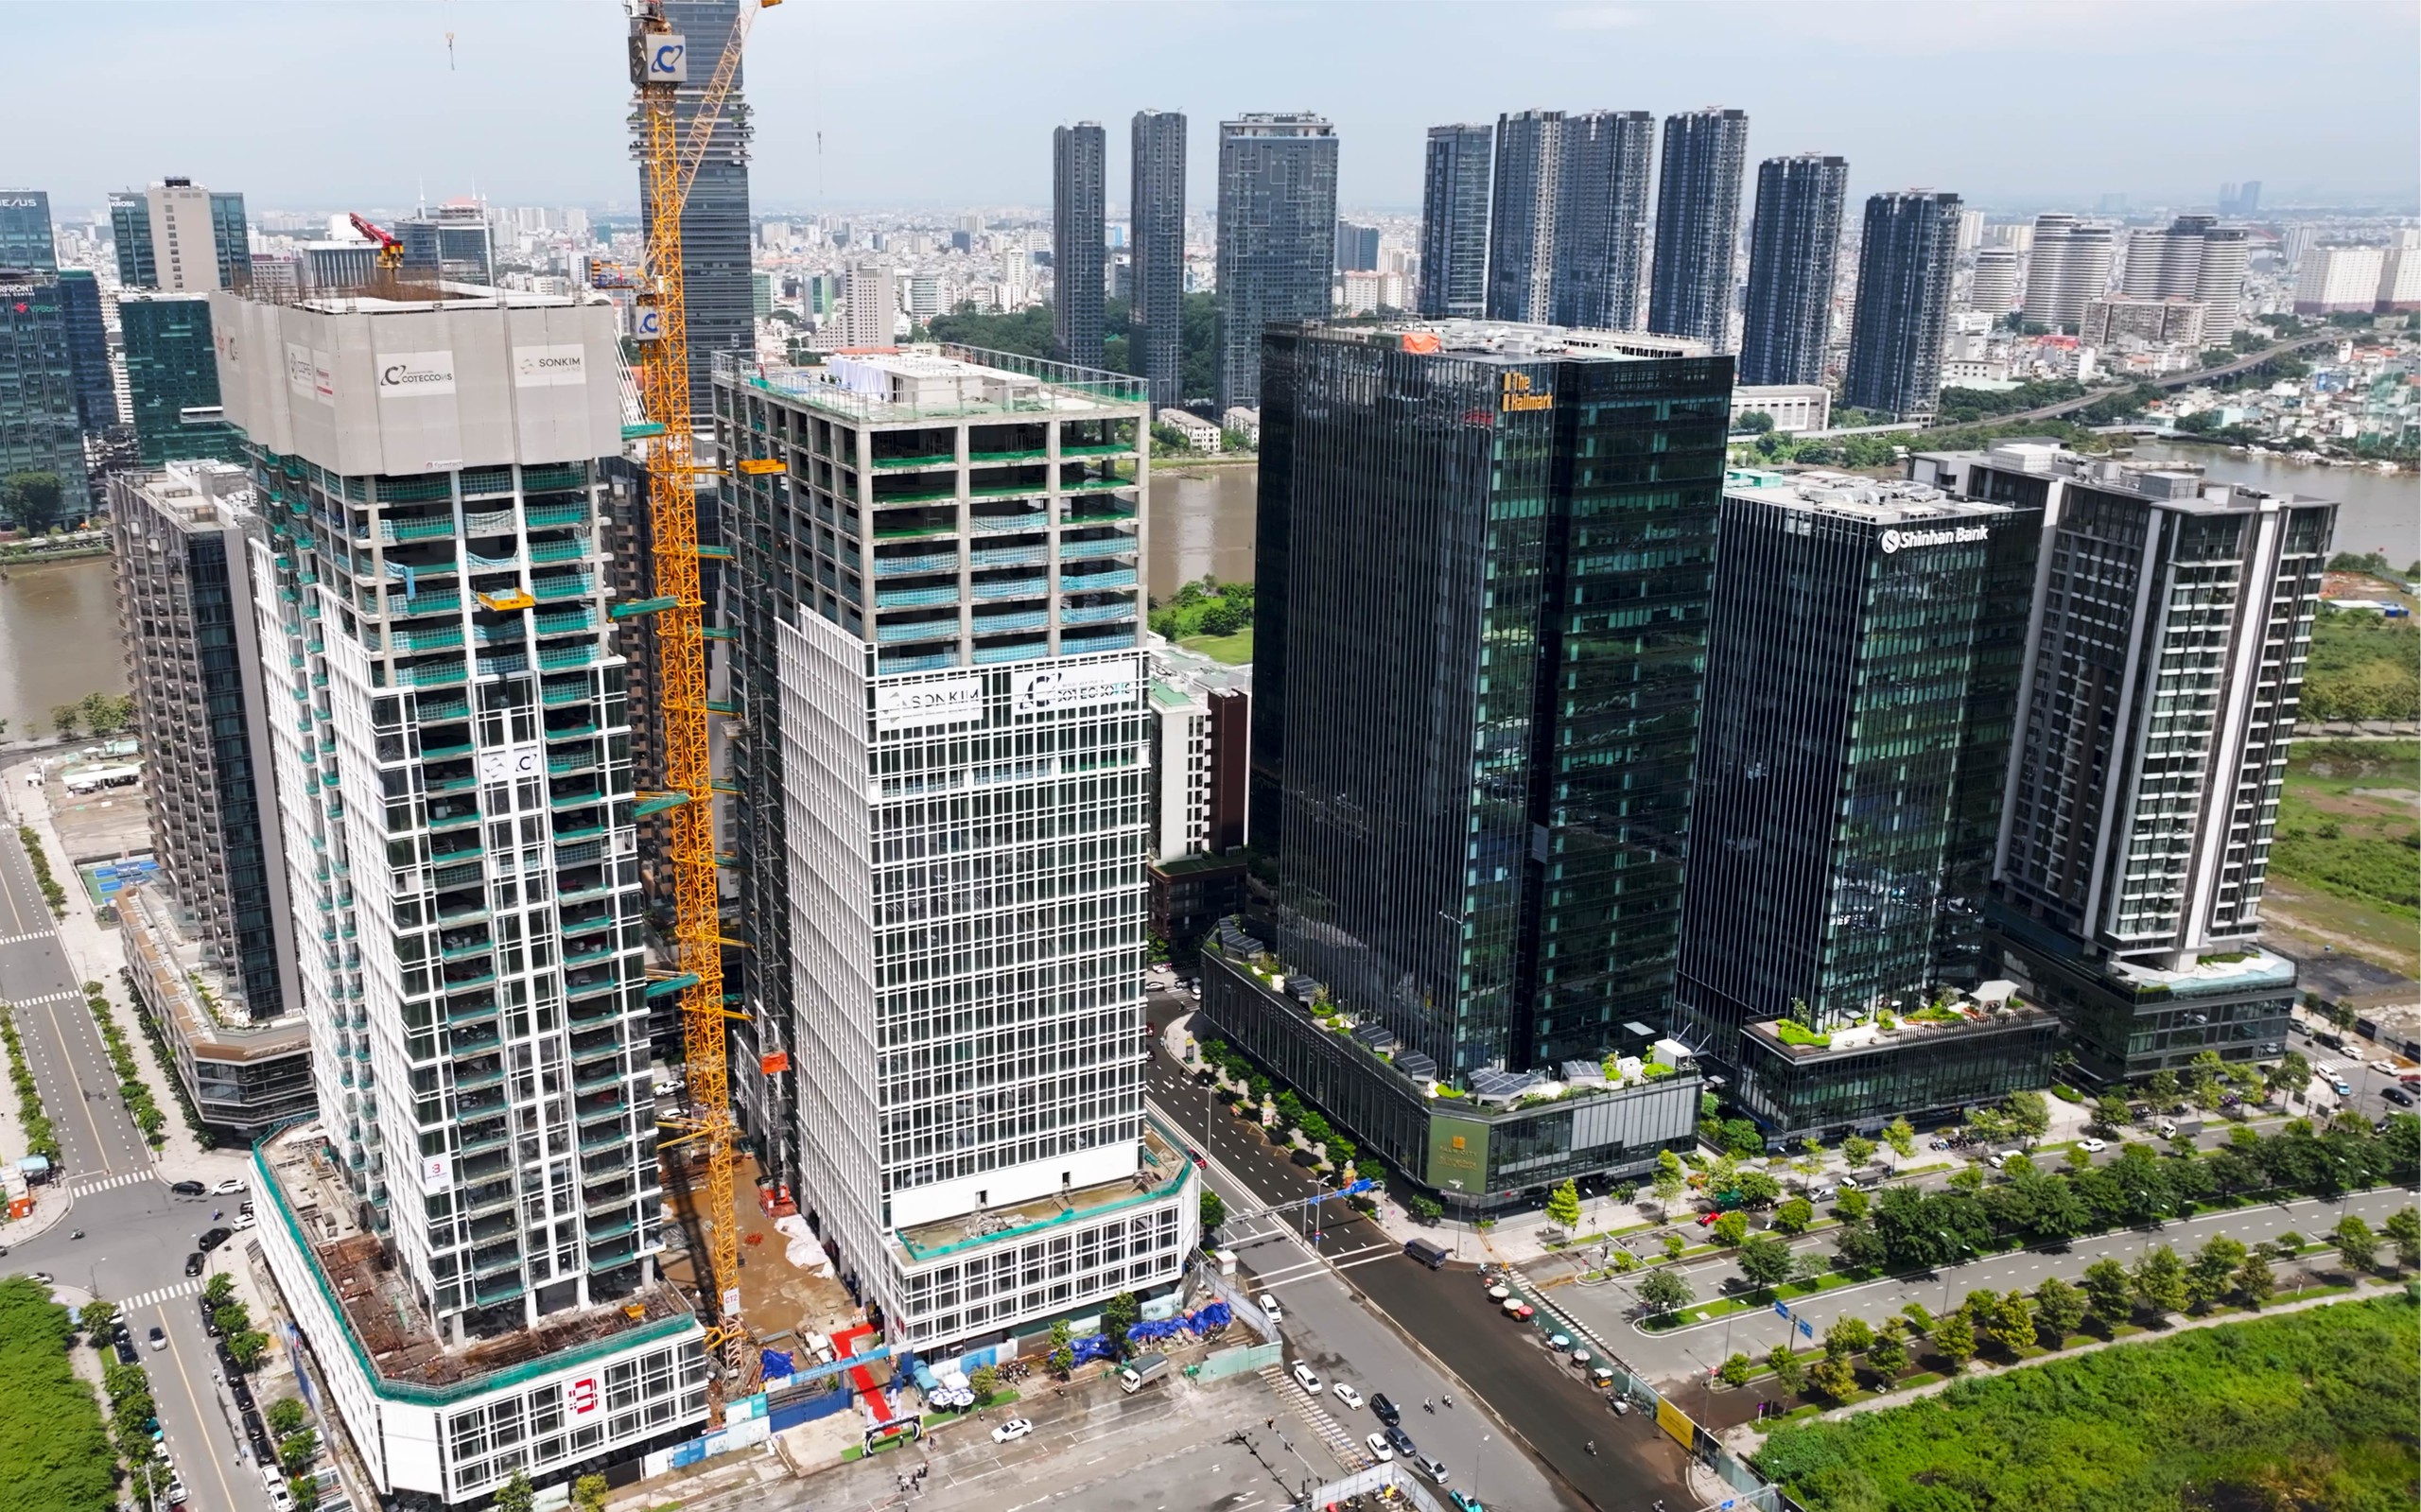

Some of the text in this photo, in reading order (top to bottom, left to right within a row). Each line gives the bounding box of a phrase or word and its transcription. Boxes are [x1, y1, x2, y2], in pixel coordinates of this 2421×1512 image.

[538, 357, 581, 368] SONKIM
[1514, 373, 1529, 390] The
[1512, 391, 1553, 411] Hallmark
[1901, 525, 1989, 548] Shinhan Bank
[724, 1294, 739, 1304] CT2
